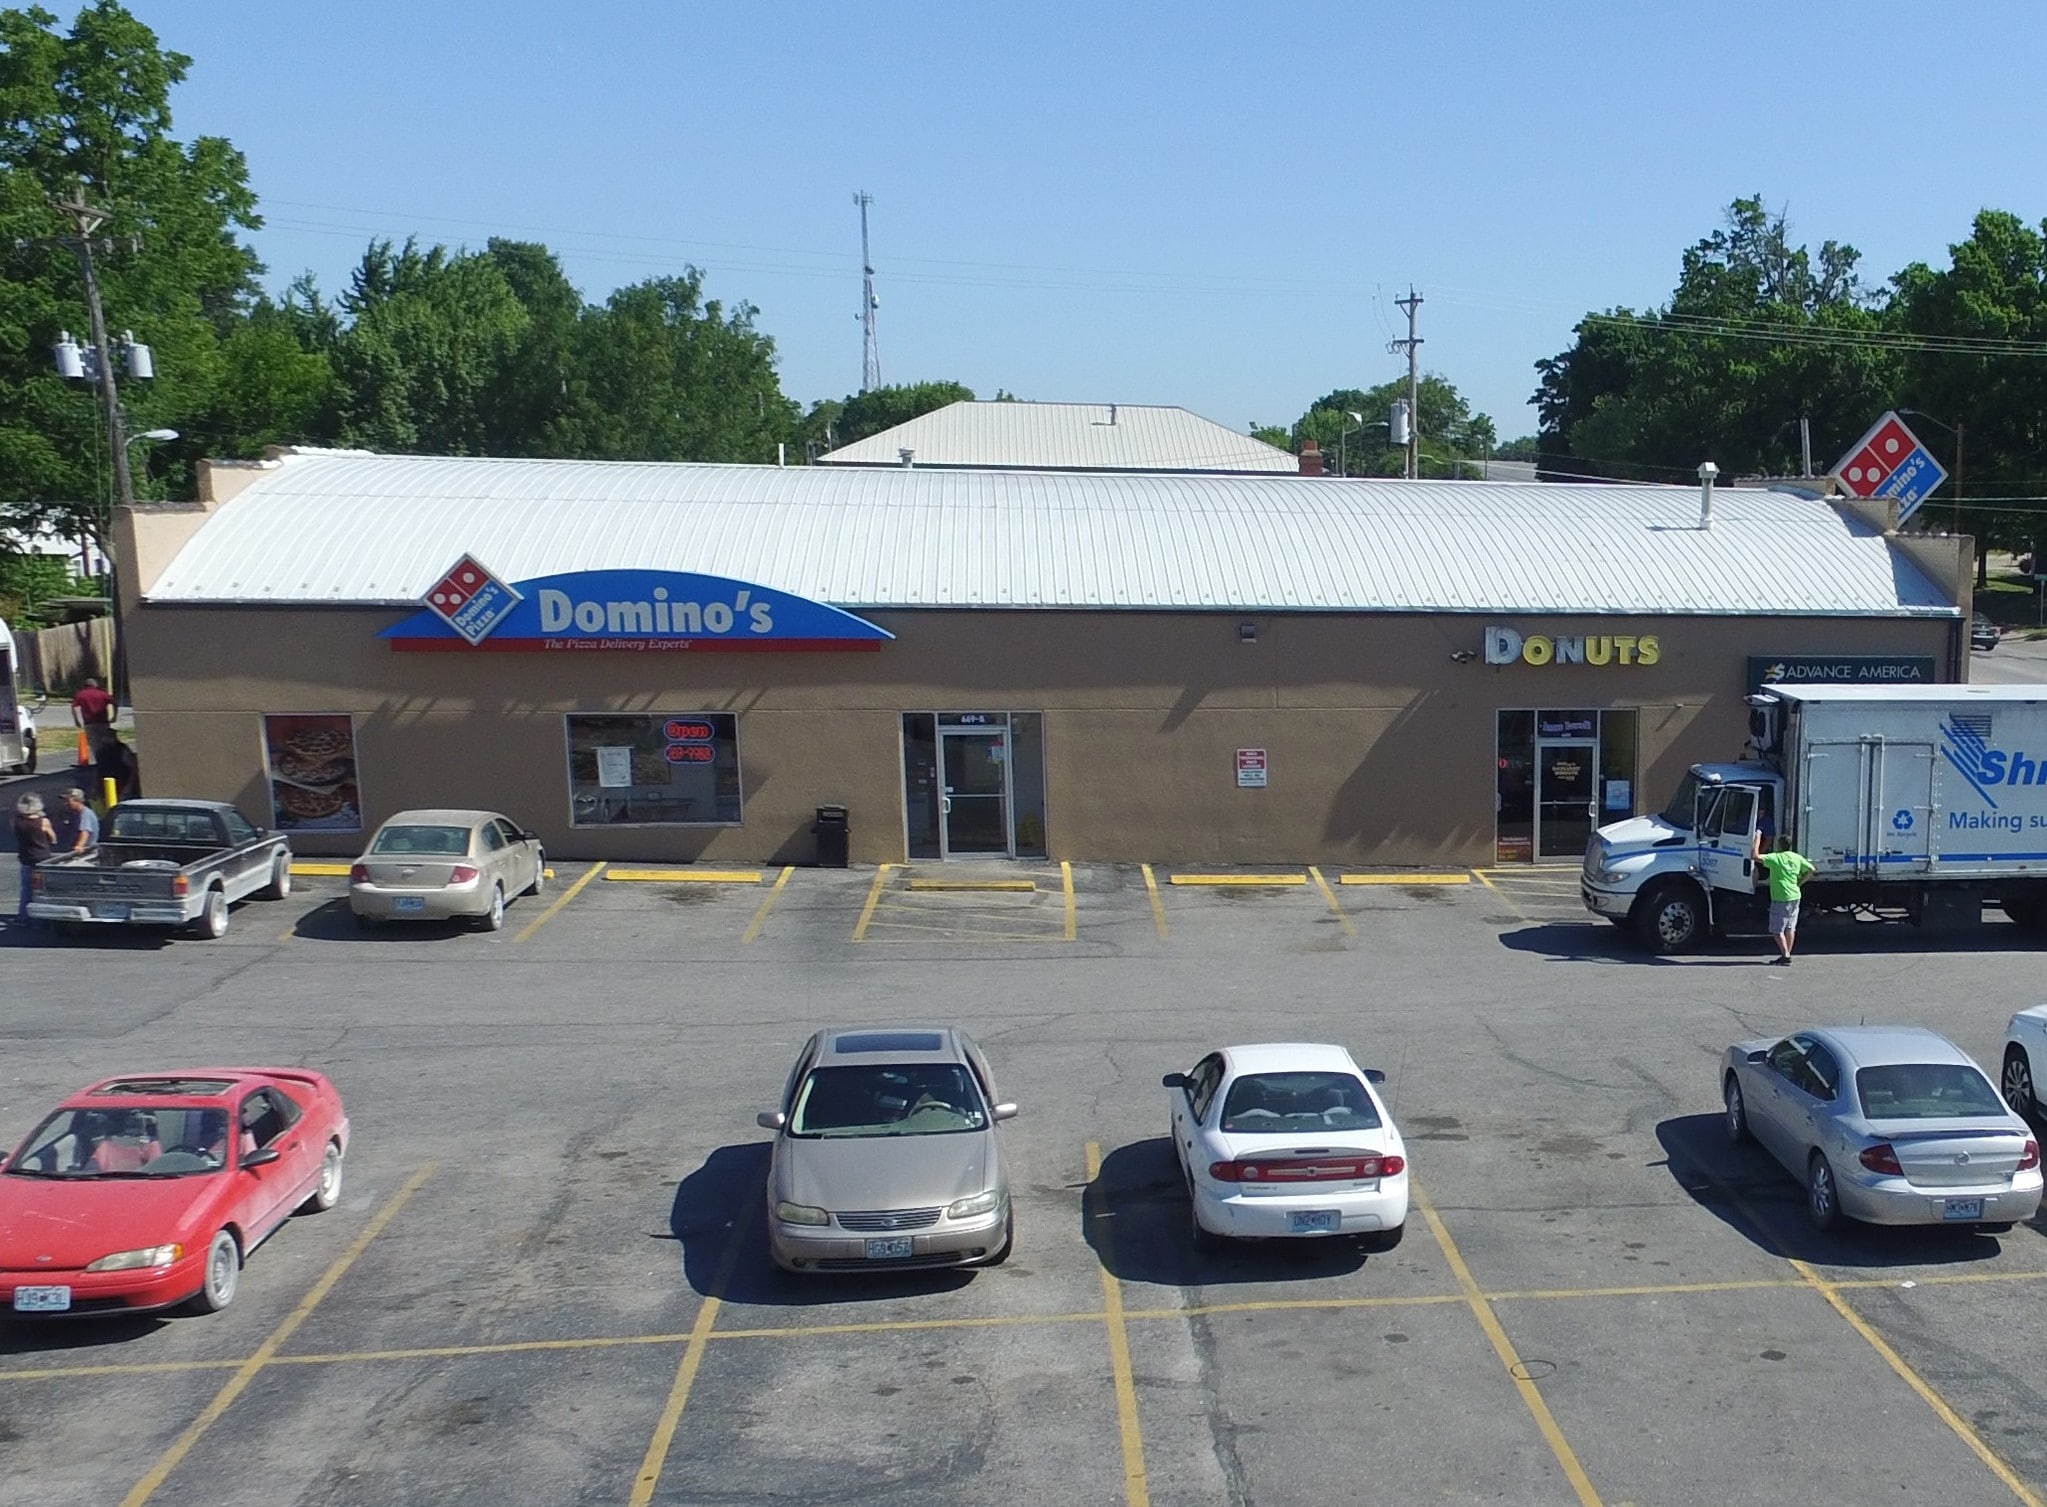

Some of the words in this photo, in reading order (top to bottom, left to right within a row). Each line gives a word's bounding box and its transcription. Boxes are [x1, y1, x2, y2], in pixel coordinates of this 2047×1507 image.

[1882, 457, 1926, 498] mino's
[455, 586, 500, 628] Domino's
[466, 607, 497, 636] Pizza
[539, 587, 773, 633] Domino's
[544, 639, 562, 649] The
[567, 639, 598, 649] Pizza
[601, 639, 646, 651] Delivery
[648, 639, 690, 651] Experts
[1485, 626, 1660, 665] DONUTS
[1786, 665, 1852, 679] ADVANCE
[1858, 665, 1922, 679] AMERICA
[1949, 811, 2023, 833] Making
